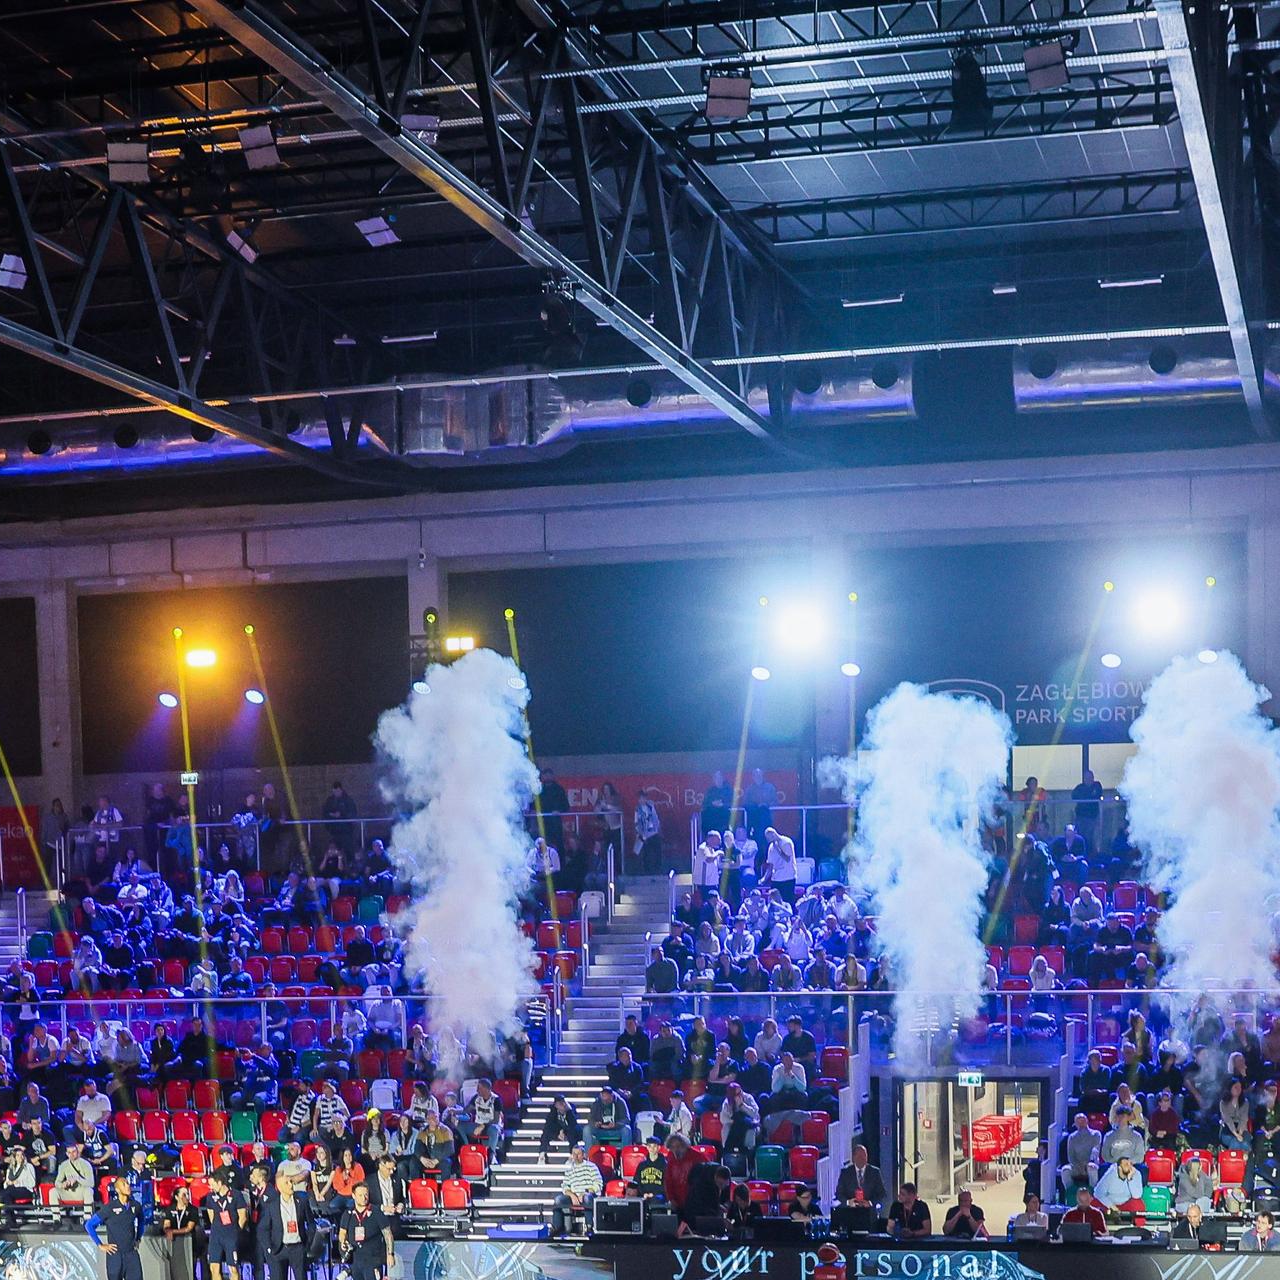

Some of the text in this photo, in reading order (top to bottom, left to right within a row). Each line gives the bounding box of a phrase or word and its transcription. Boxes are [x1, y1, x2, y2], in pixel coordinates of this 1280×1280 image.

[1015, 681, 1147, 704] ZAGŁĘBIOW
[1015, 705, 1140, 724] PARK SPORT
